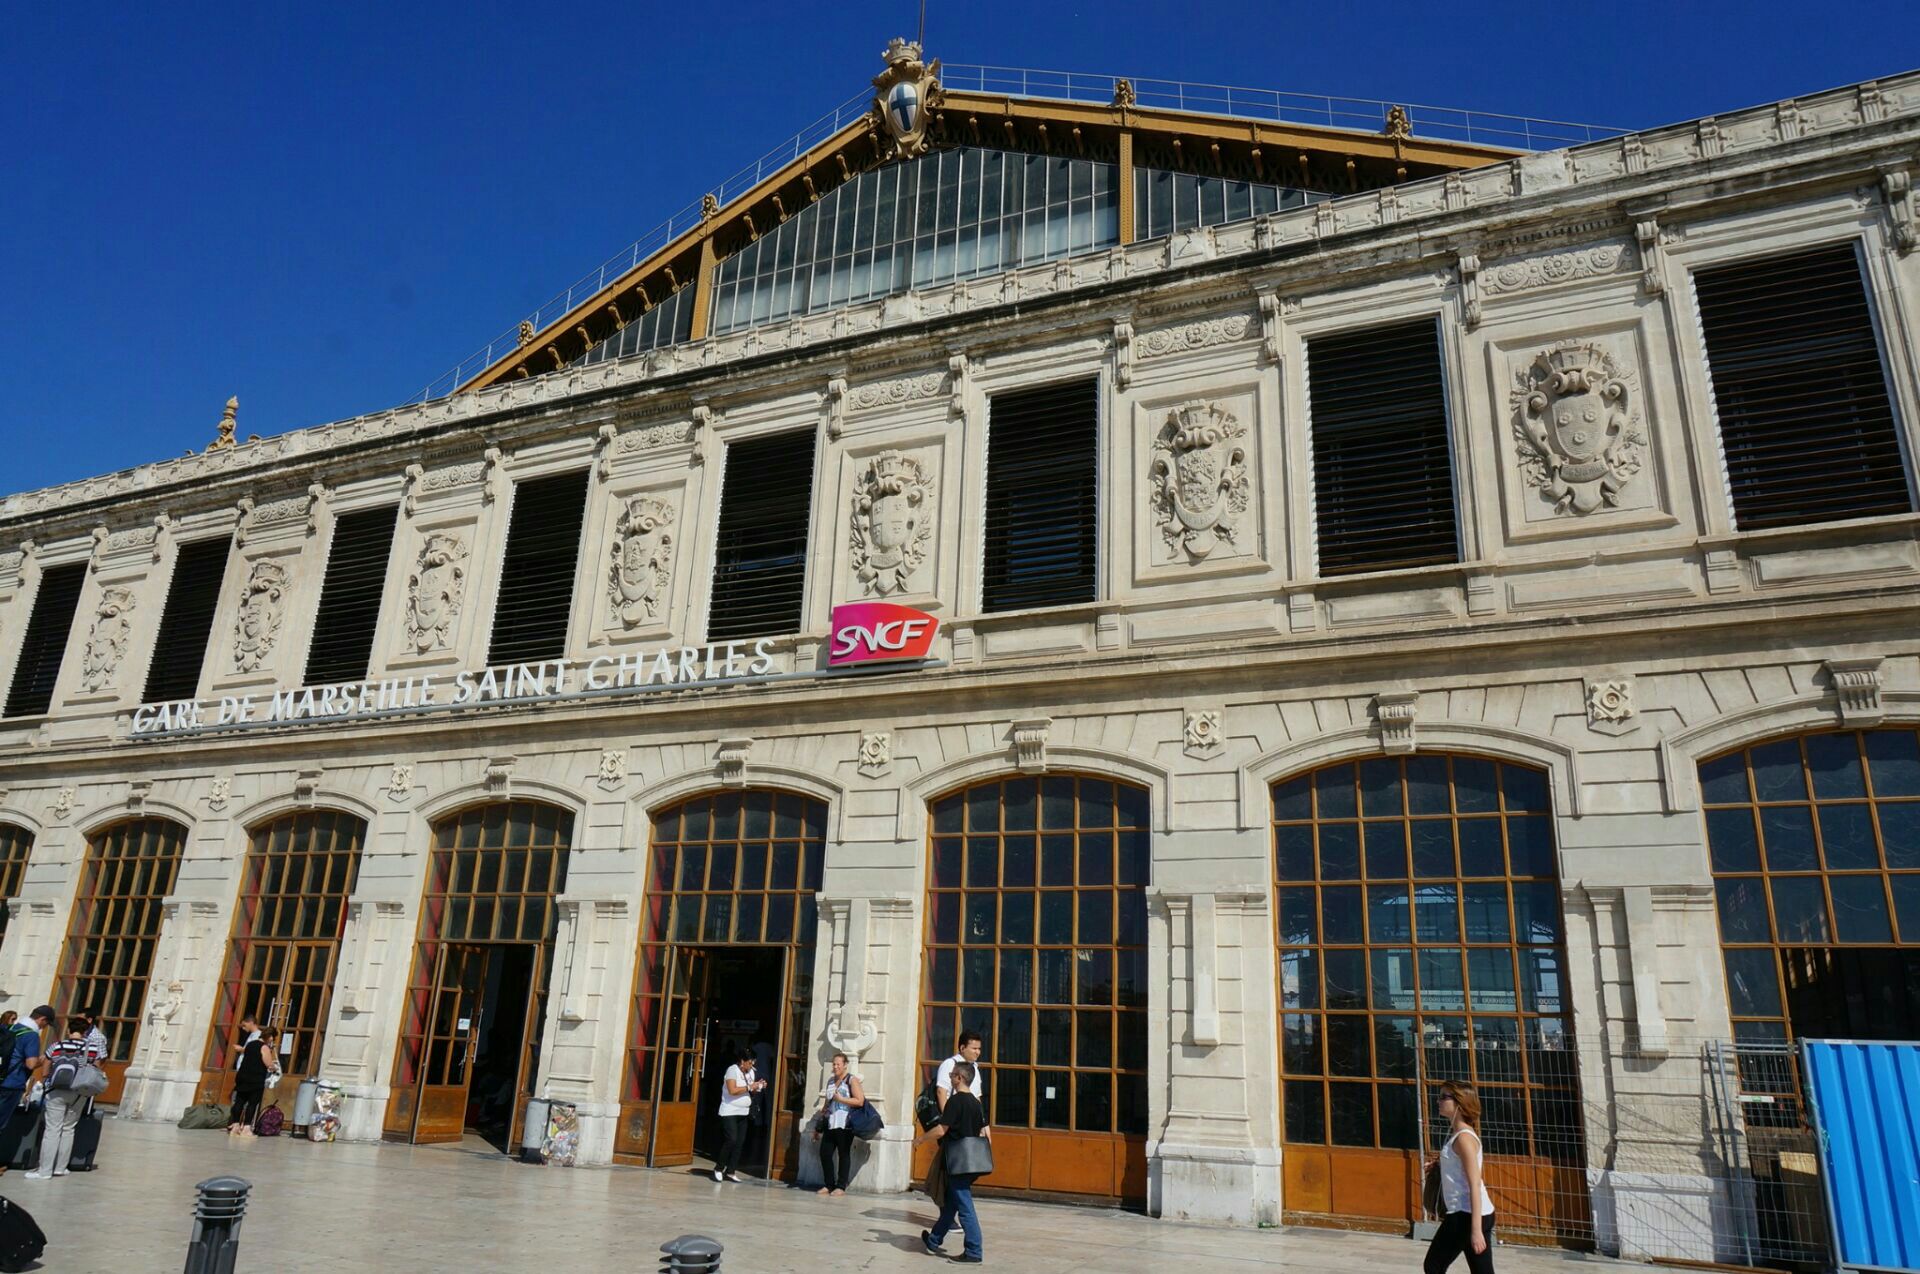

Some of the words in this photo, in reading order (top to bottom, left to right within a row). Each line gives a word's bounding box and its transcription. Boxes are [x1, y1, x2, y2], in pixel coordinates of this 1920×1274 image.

[832, 619, 930, 656] SNCF
[133, 699, 207, 734] GARE
[217, 694, 257, 724] DE
[267, 674, 438, 721] MARSEILLE
[454, 658, 572, 702] SAINT
[586, 638, 776, 690] CHARLES
